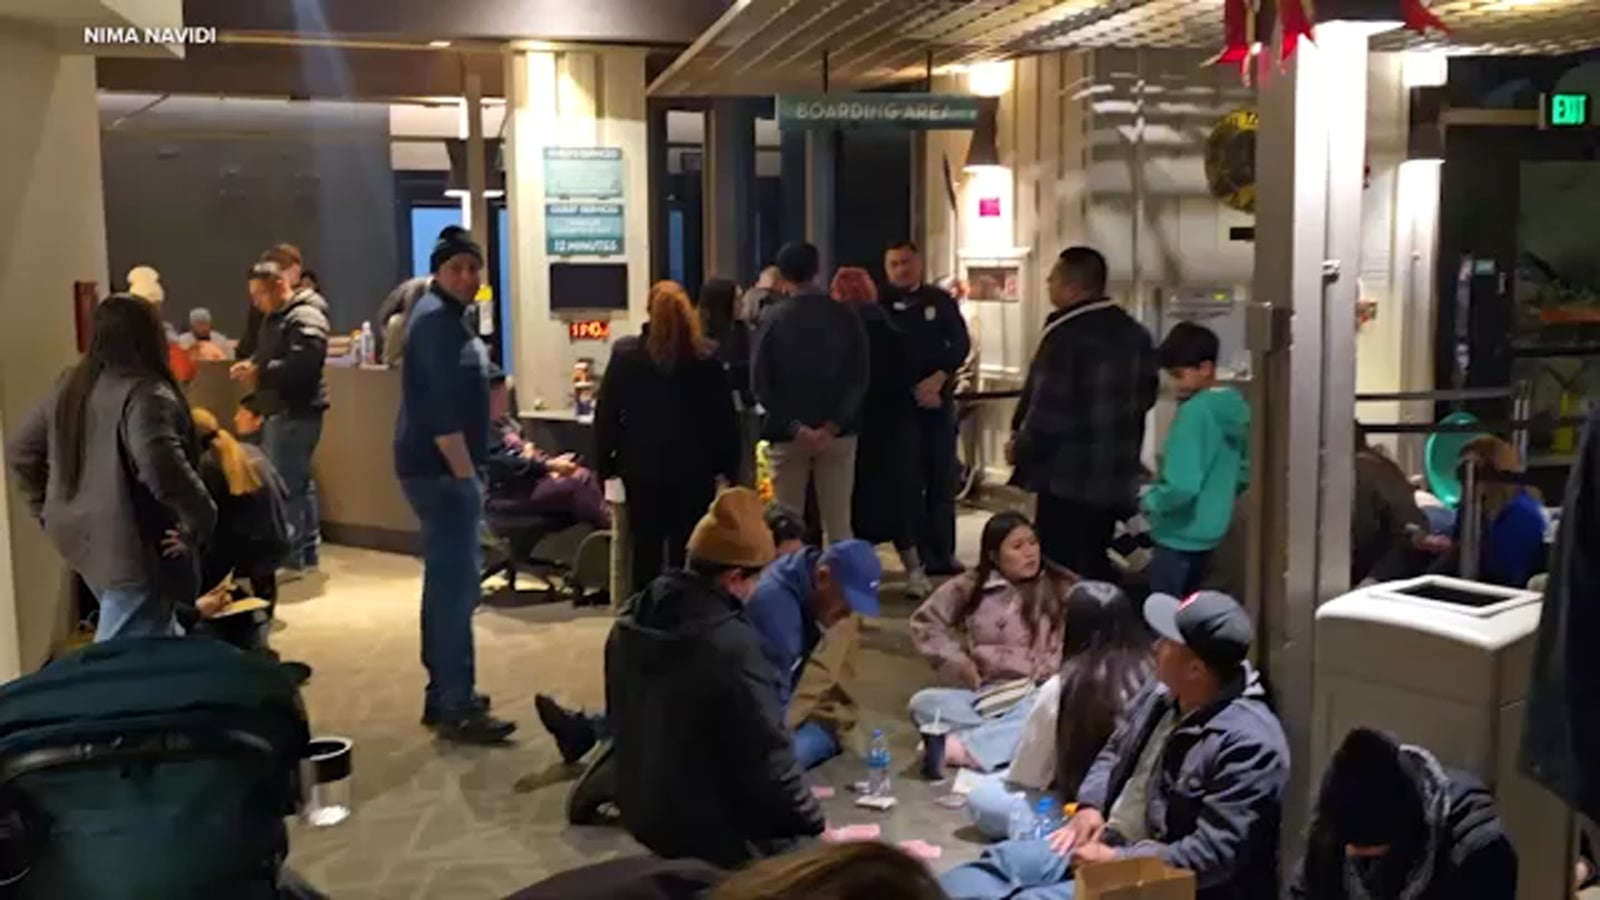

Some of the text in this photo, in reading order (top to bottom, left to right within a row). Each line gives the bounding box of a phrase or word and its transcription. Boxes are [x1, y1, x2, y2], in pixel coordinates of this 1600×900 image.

[797, 102, 900, 119] BOARDING
[1553, 95, 1586, 125] EXIT
[568, 239, 618, 252] MINUTES
